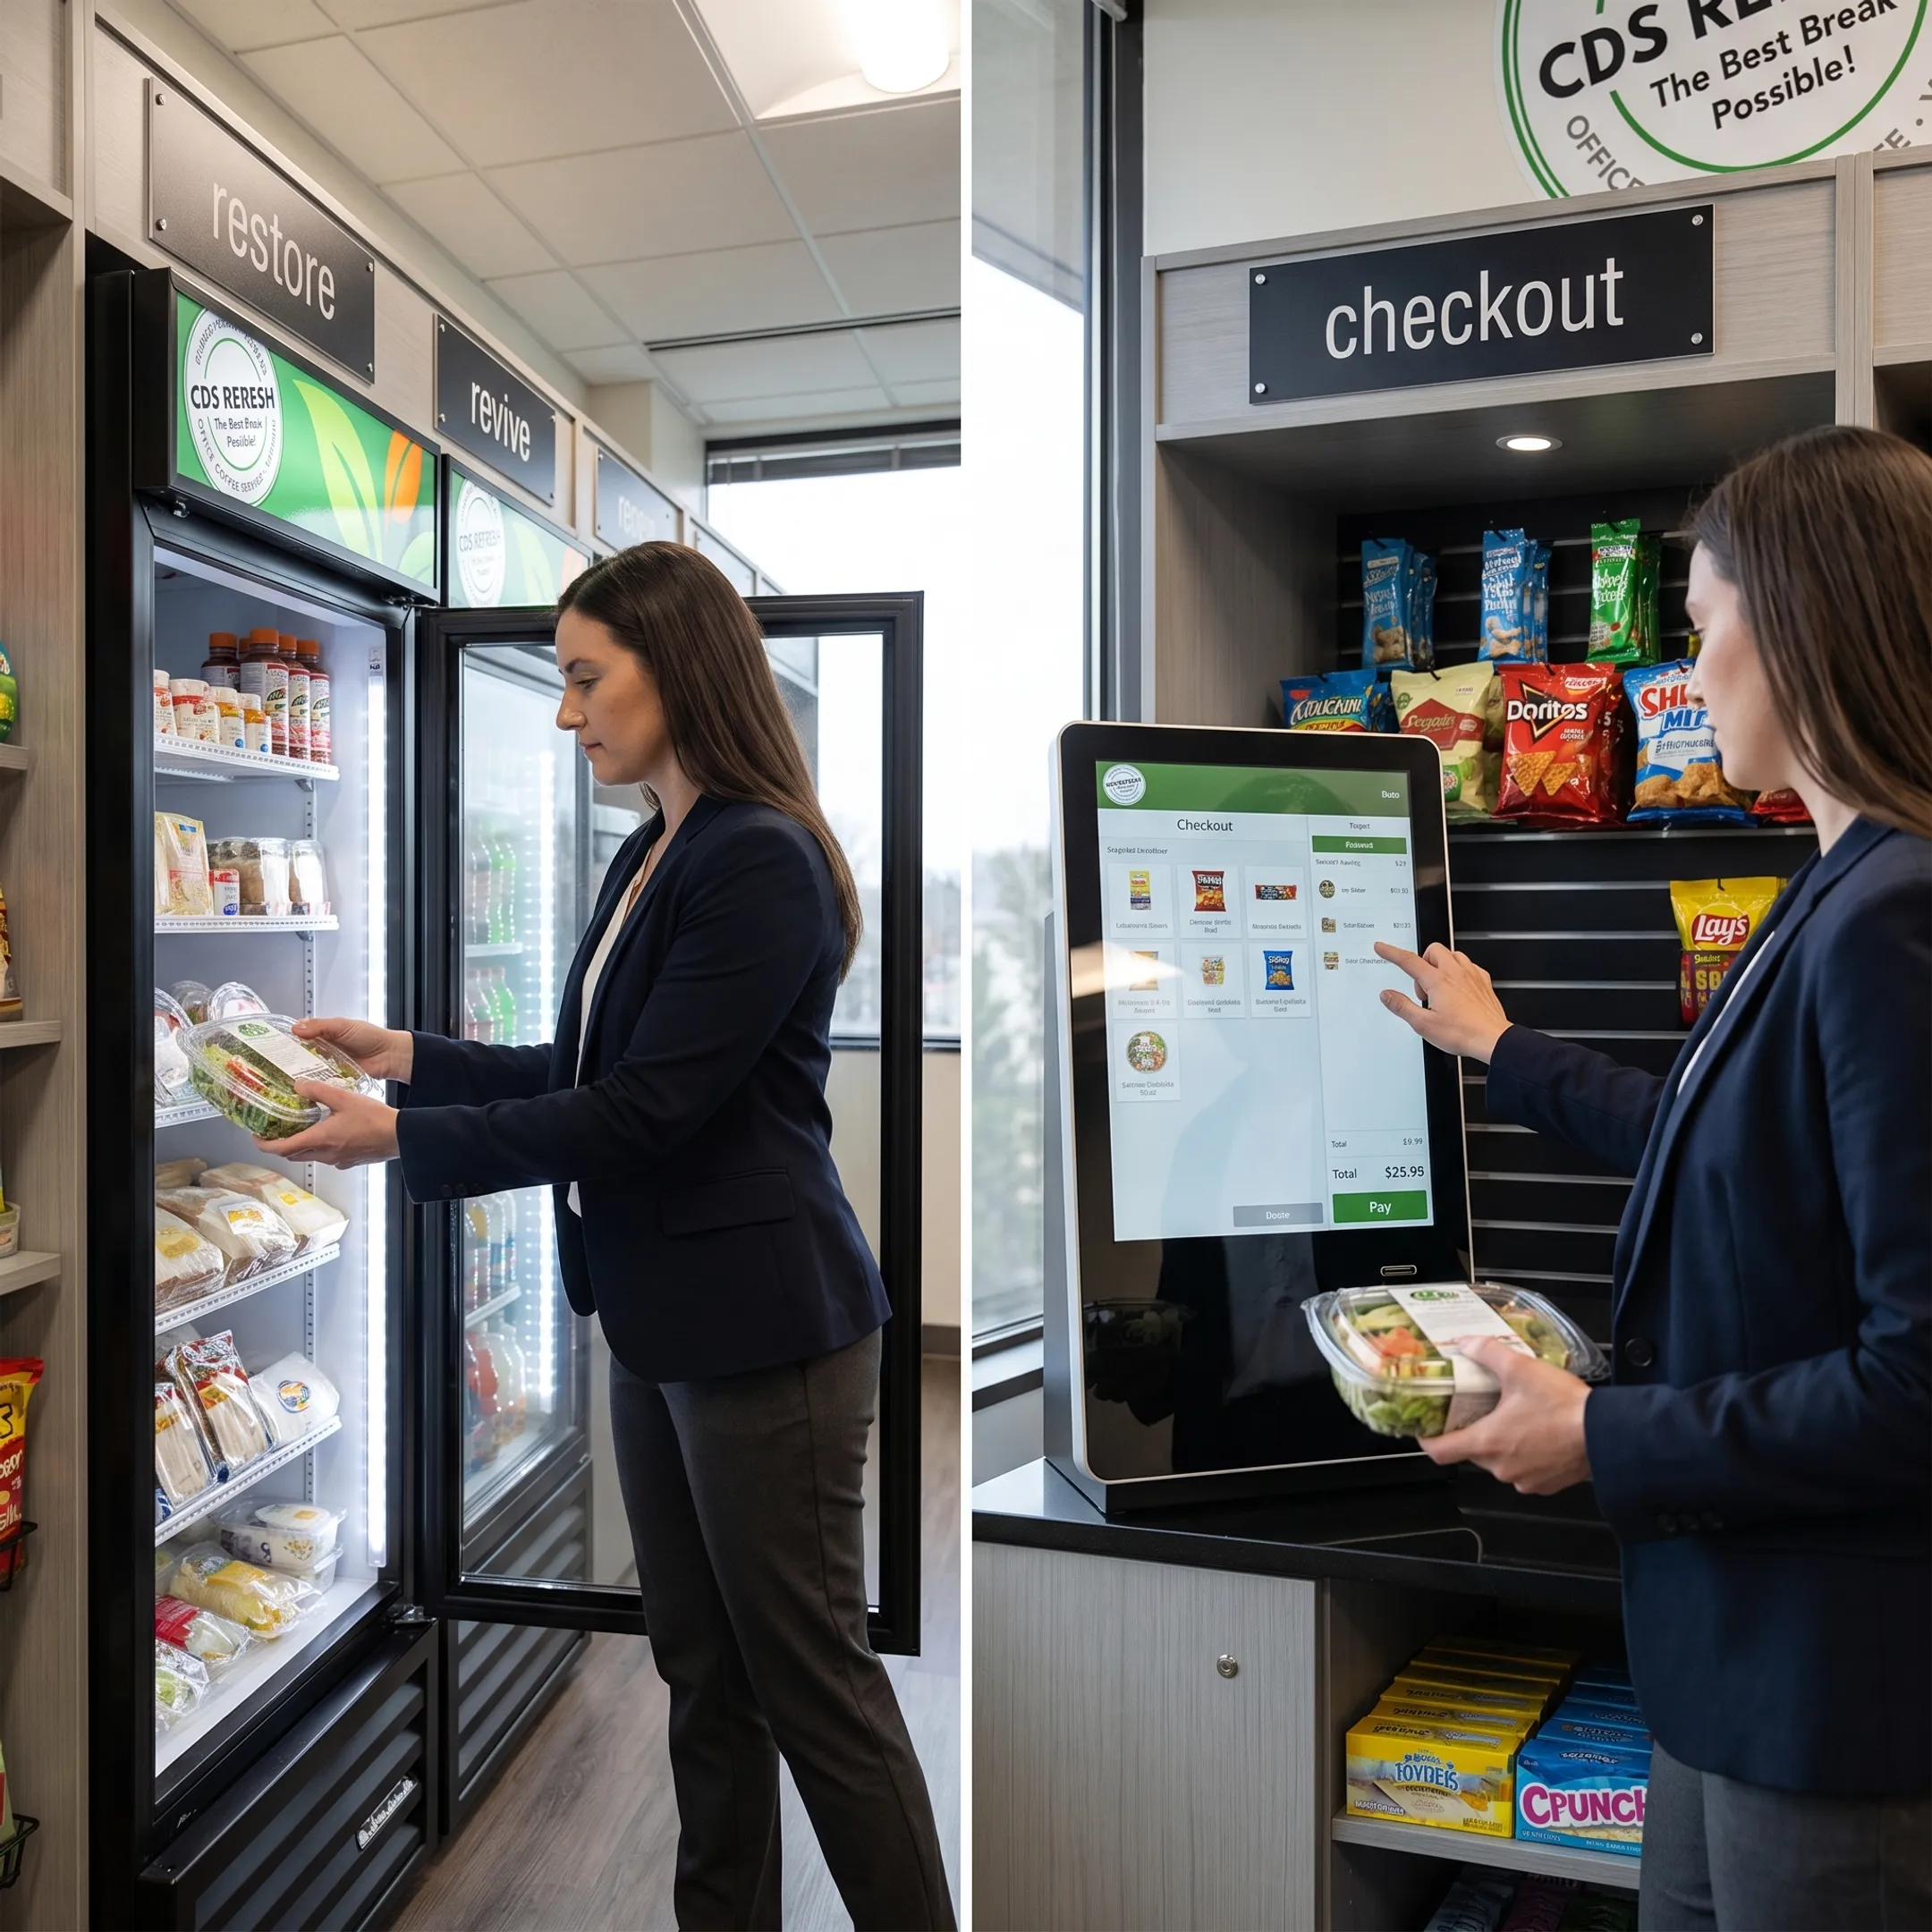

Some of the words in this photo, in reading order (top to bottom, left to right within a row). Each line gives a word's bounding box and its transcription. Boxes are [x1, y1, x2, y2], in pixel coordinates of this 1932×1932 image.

[1538, 4, 1668, 98] CDS
[1649, 70, 1710, 108] The
[1718, 30, 1793, 80] Best
[1798, 0, 1898, 47] Break
[1711, 45, 1857, 131] Possible!
[213, 182, 335, 320] restore
[1326, 257, 1624, 360] checkout
[191, 385, 220, 410] CDS
[224, 386, 275, 410] RERESH
[214, 418, 227, 430] The
[229, 418, 244, 429] Best
[471, 381, 530, 462] revive
[1507, 699, 1589, 721] Doritos
[1177, 818, 1233, 832] Checkout
[1331, 1140, 1348, 1148] Total
[1332, 1168, 1358, 1180] Total
[1385, 1165, 1425, 1180] $25.95
[1369, 1200, 1392, 1216] Pay
